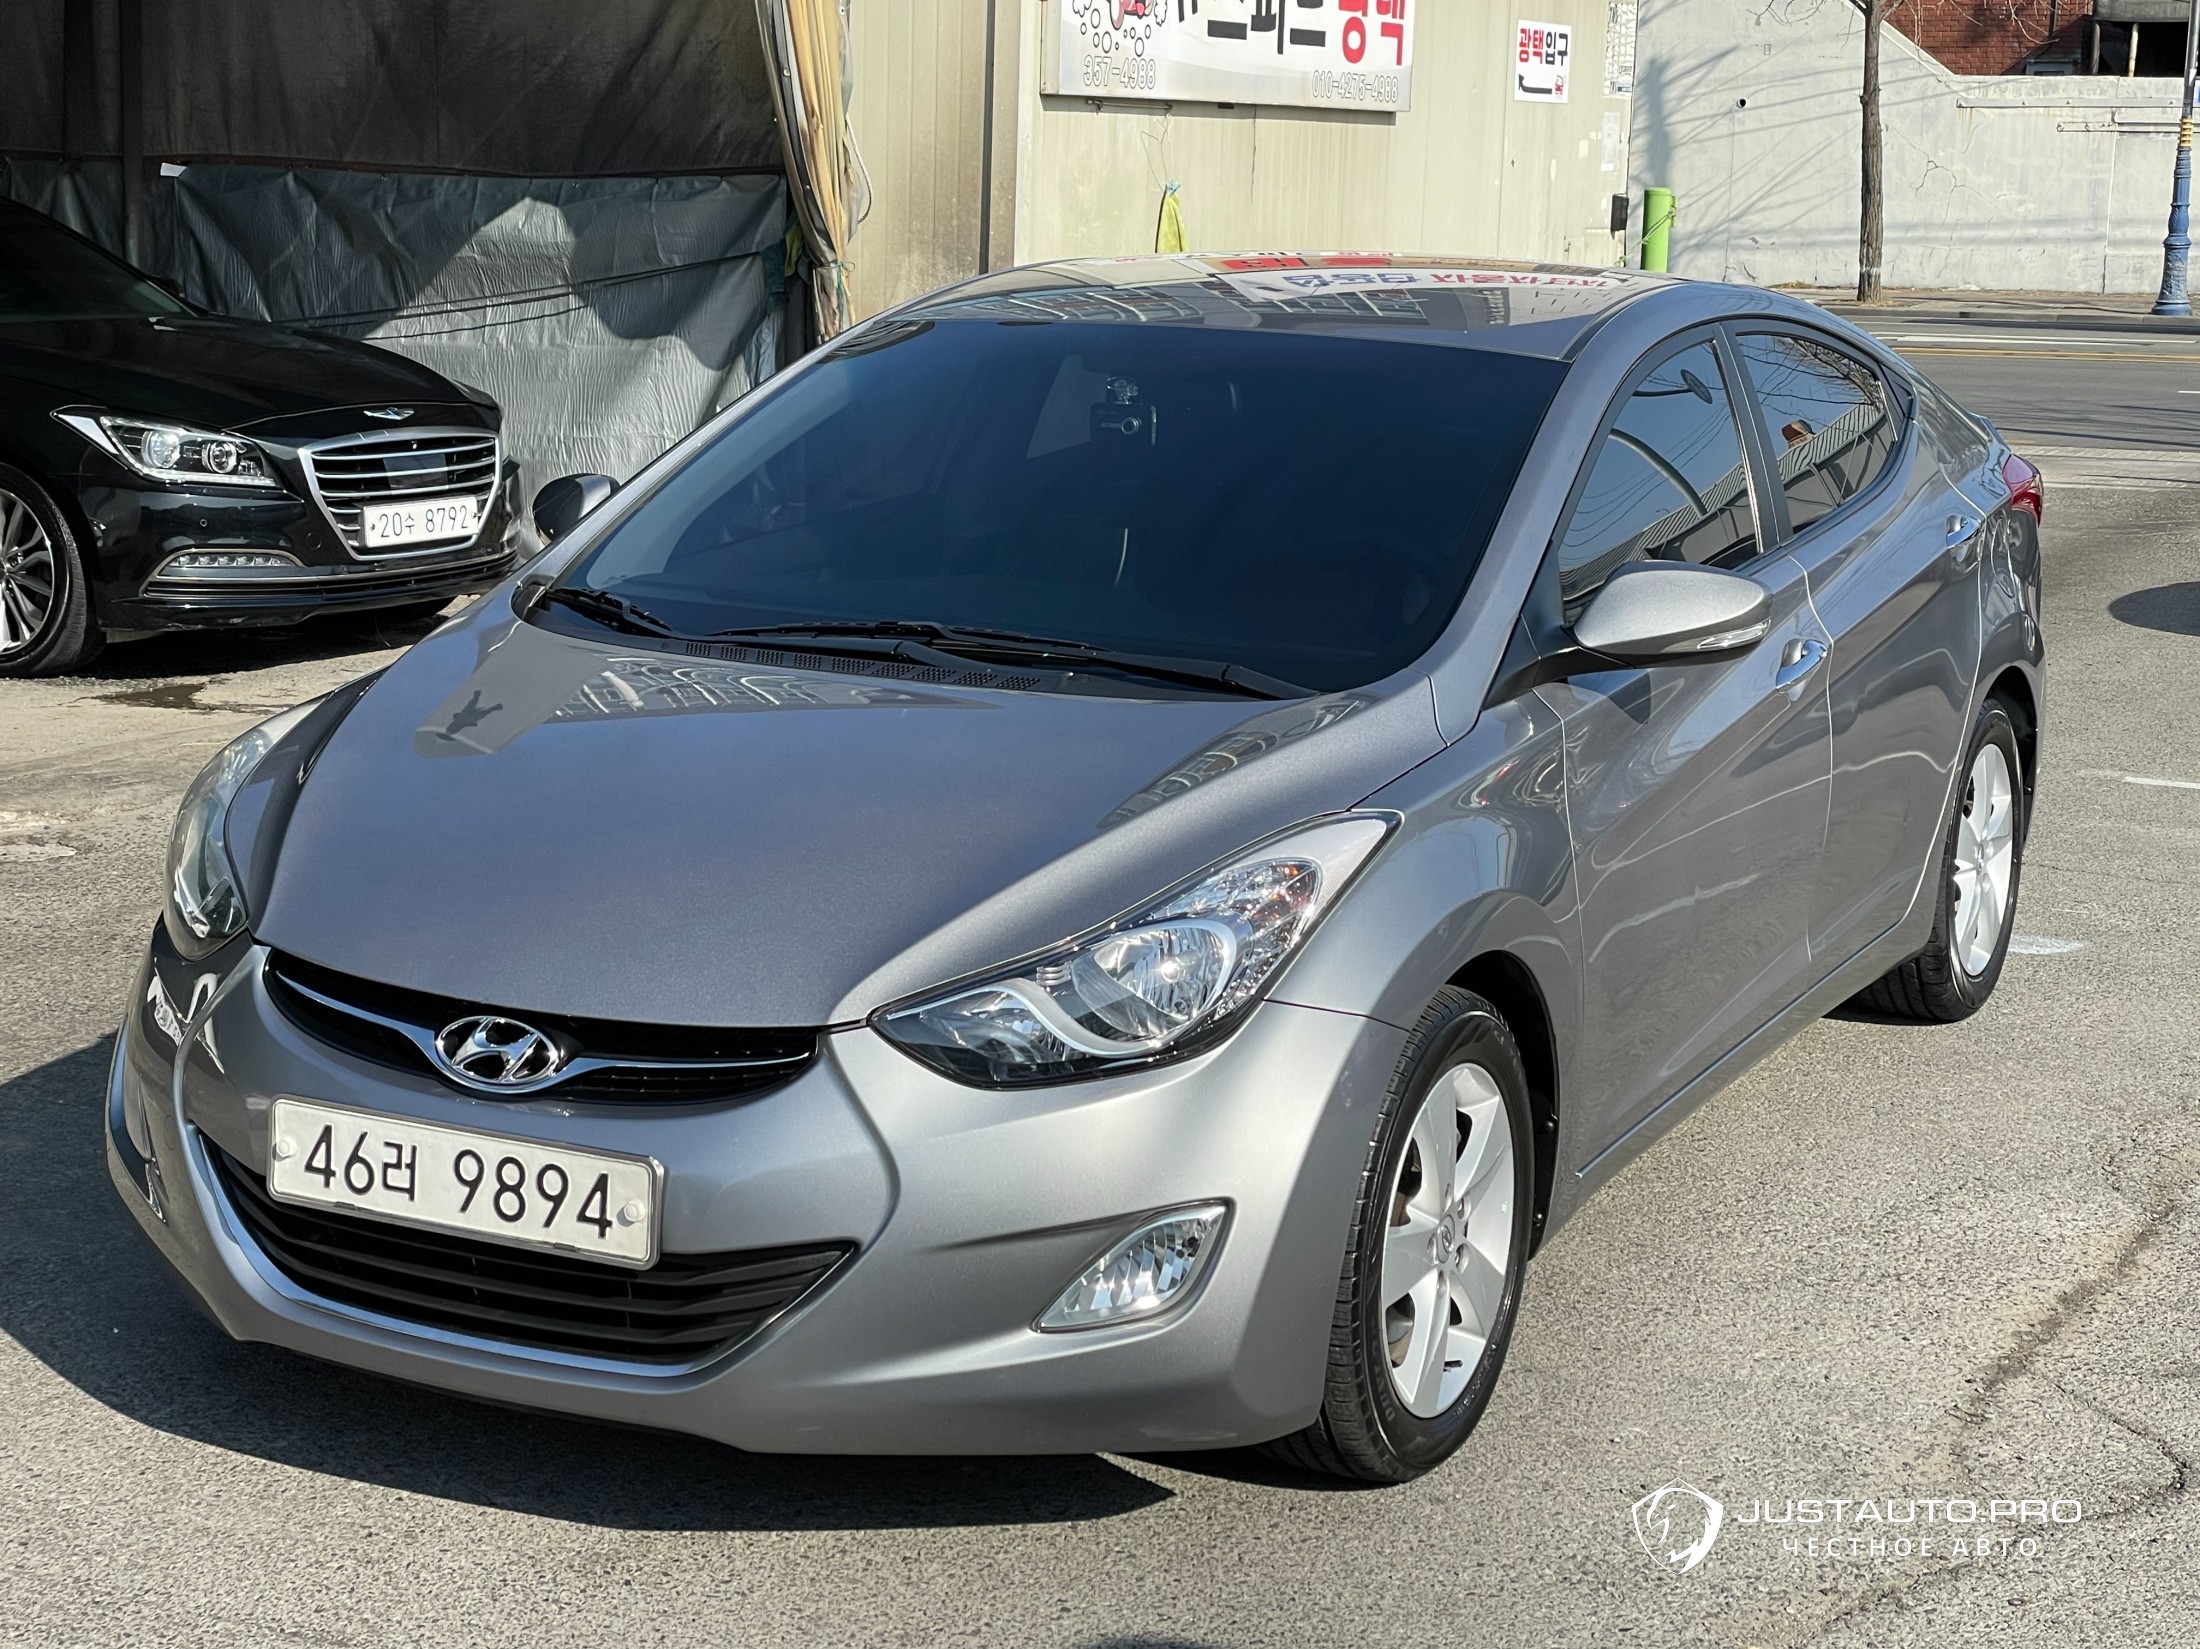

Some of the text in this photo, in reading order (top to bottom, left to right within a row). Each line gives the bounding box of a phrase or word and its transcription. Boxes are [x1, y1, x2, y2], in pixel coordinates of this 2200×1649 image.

[1518, 28, 1569, 66] 광택입구
[1083, 55, 1156, 90] 357-4988
[1312, 70, 1399, 103] 010-4275-4988
[379, 505, 468, 538] 20수 8792
[304, 1123, 613, 1240] 46러 9894
